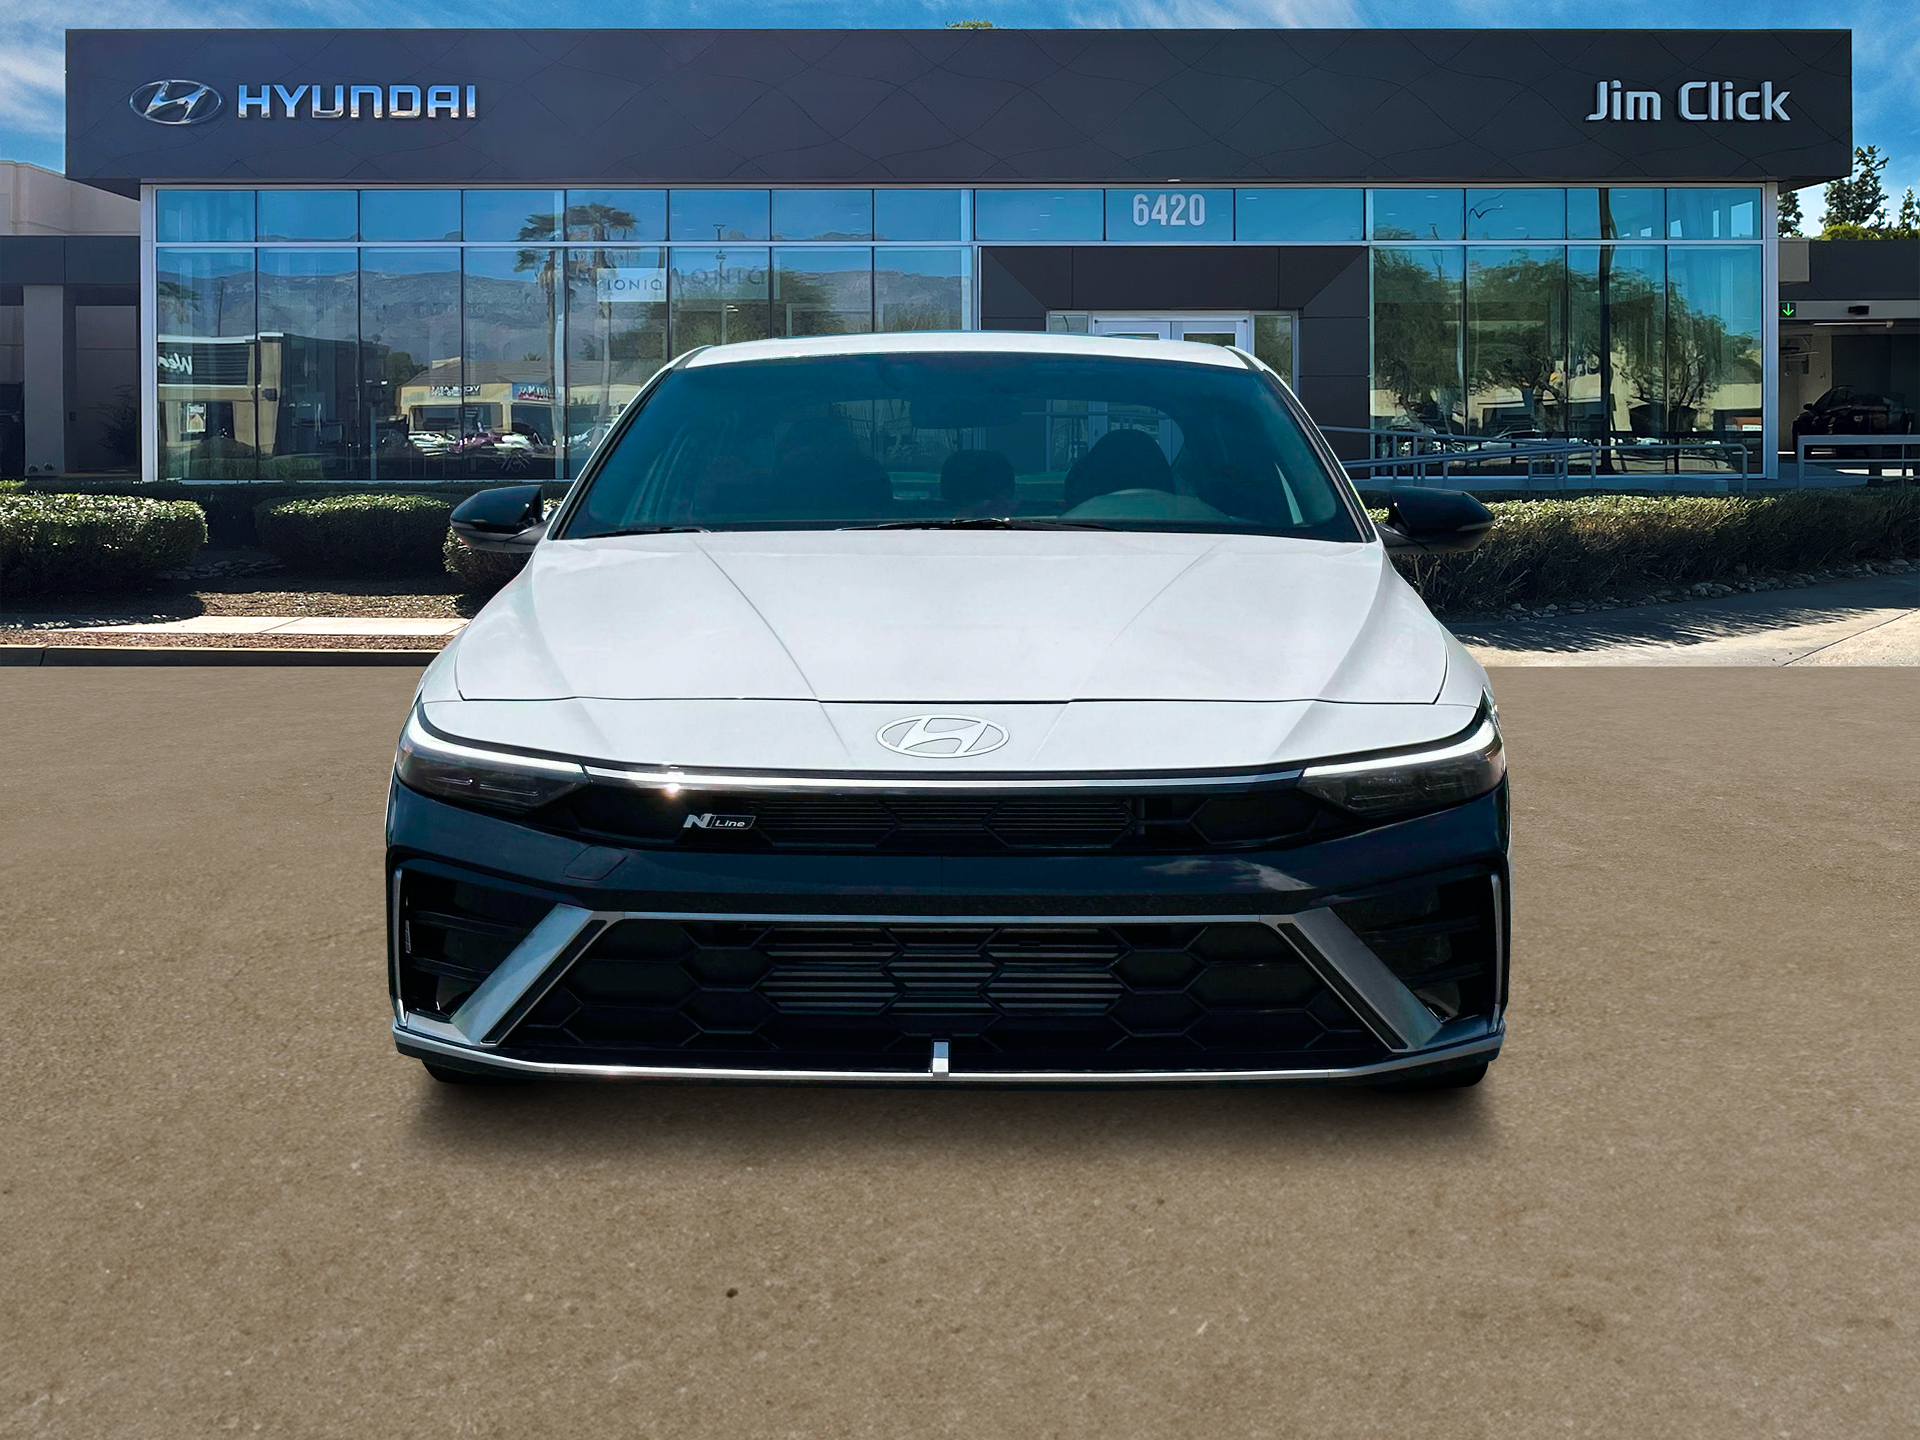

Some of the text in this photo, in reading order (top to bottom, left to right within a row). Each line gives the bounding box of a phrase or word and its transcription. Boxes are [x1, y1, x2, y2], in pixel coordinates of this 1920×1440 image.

[237, 84, 477, 119] HYUNDAI
[1585, 80, 1791, 121] Jim Click
[1133, 193, 1206, 226] 6420
[606, 277, 663, 291] IONIQ
